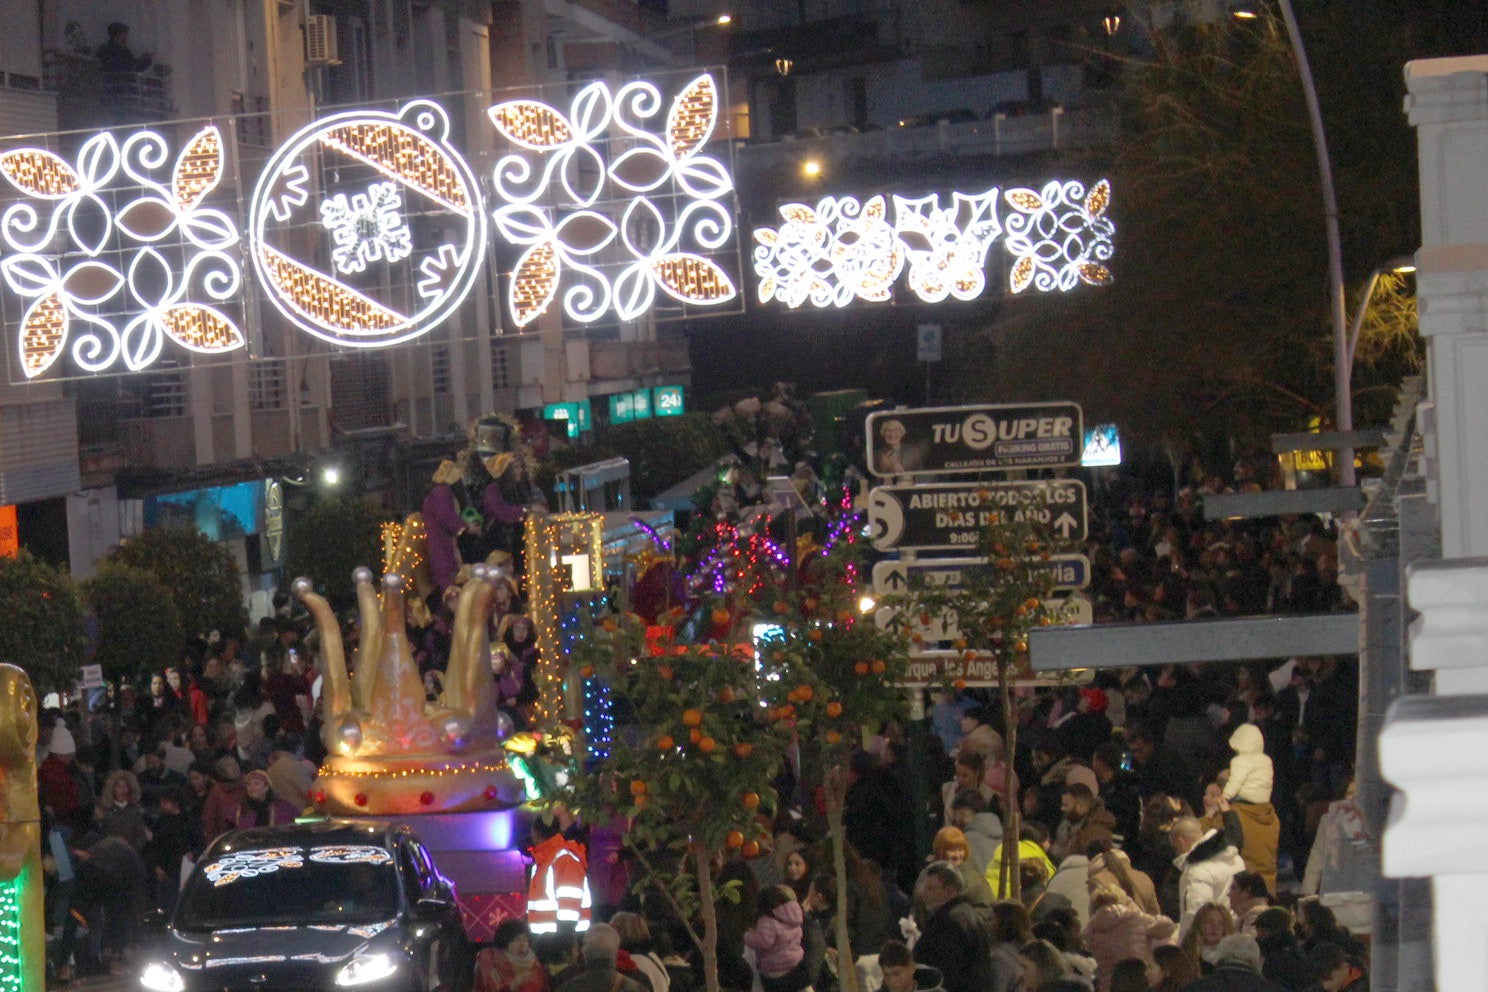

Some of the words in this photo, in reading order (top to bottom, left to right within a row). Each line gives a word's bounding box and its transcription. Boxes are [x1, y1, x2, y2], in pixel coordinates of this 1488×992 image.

[932, 423, 961, 444] TU
[1038, 440, 1070, 452] GRATIS
[910, 492, 980, 509] ABIERTO
[967, 659, 1019, 680] Angees
